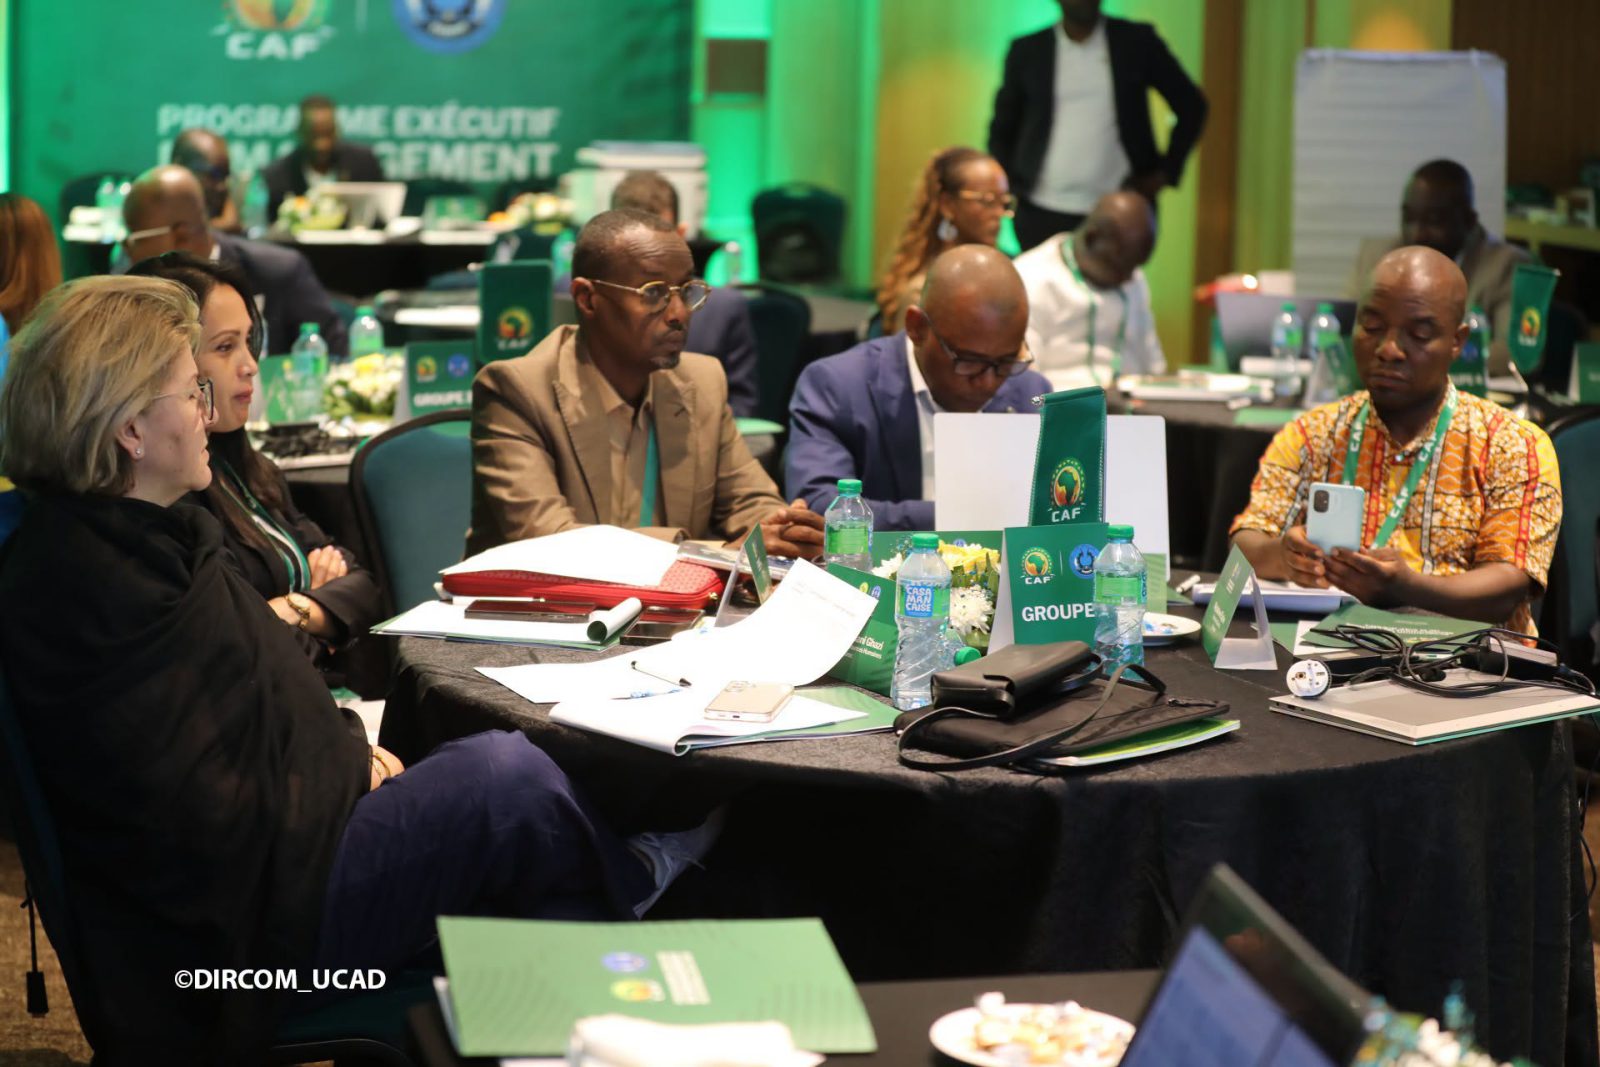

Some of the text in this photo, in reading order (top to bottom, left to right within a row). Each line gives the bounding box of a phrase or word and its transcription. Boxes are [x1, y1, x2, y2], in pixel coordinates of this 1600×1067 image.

[226, 32, 319, 59] CAF
[157, 100, 559, 138] PROGRAME EXÉCUTIF
[1052, 508, 1081, 522] CAF
[1022, 603, 1096, 621] GROUPE
